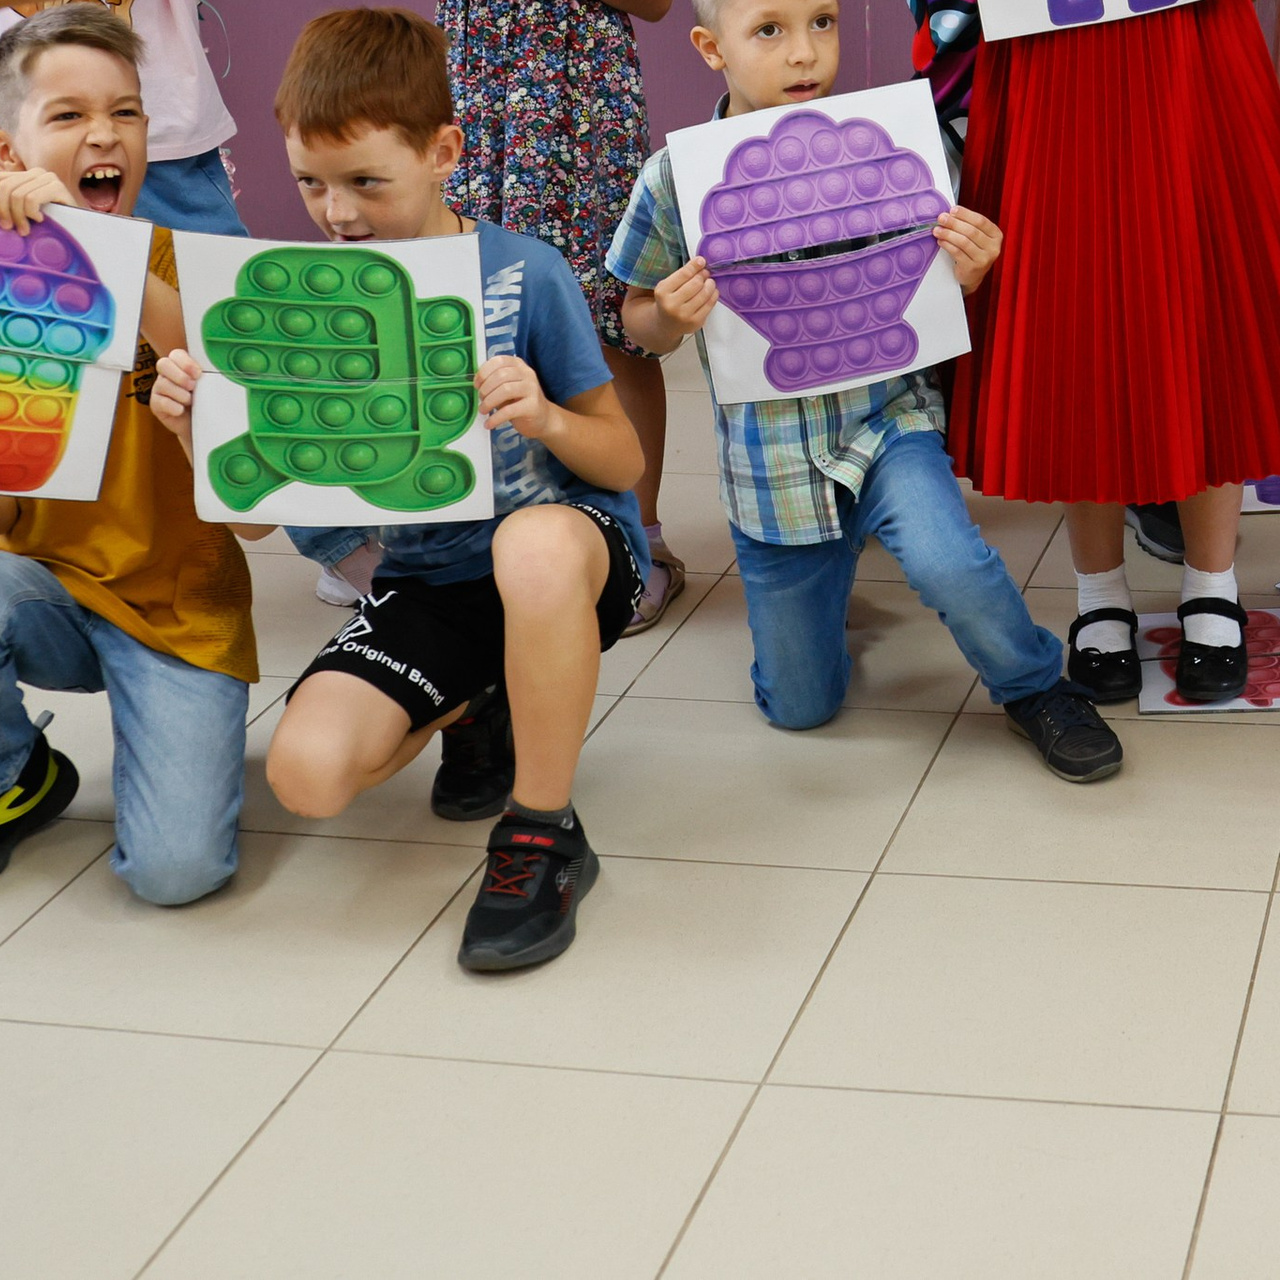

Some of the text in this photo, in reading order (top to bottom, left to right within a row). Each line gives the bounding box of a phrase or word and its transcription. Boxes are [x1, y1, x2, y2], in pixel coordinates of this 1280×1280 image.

[571, 503, 611, 526] rand
[342, 641, 408, 675] Original
[408, 668, 446, 708] Brand
